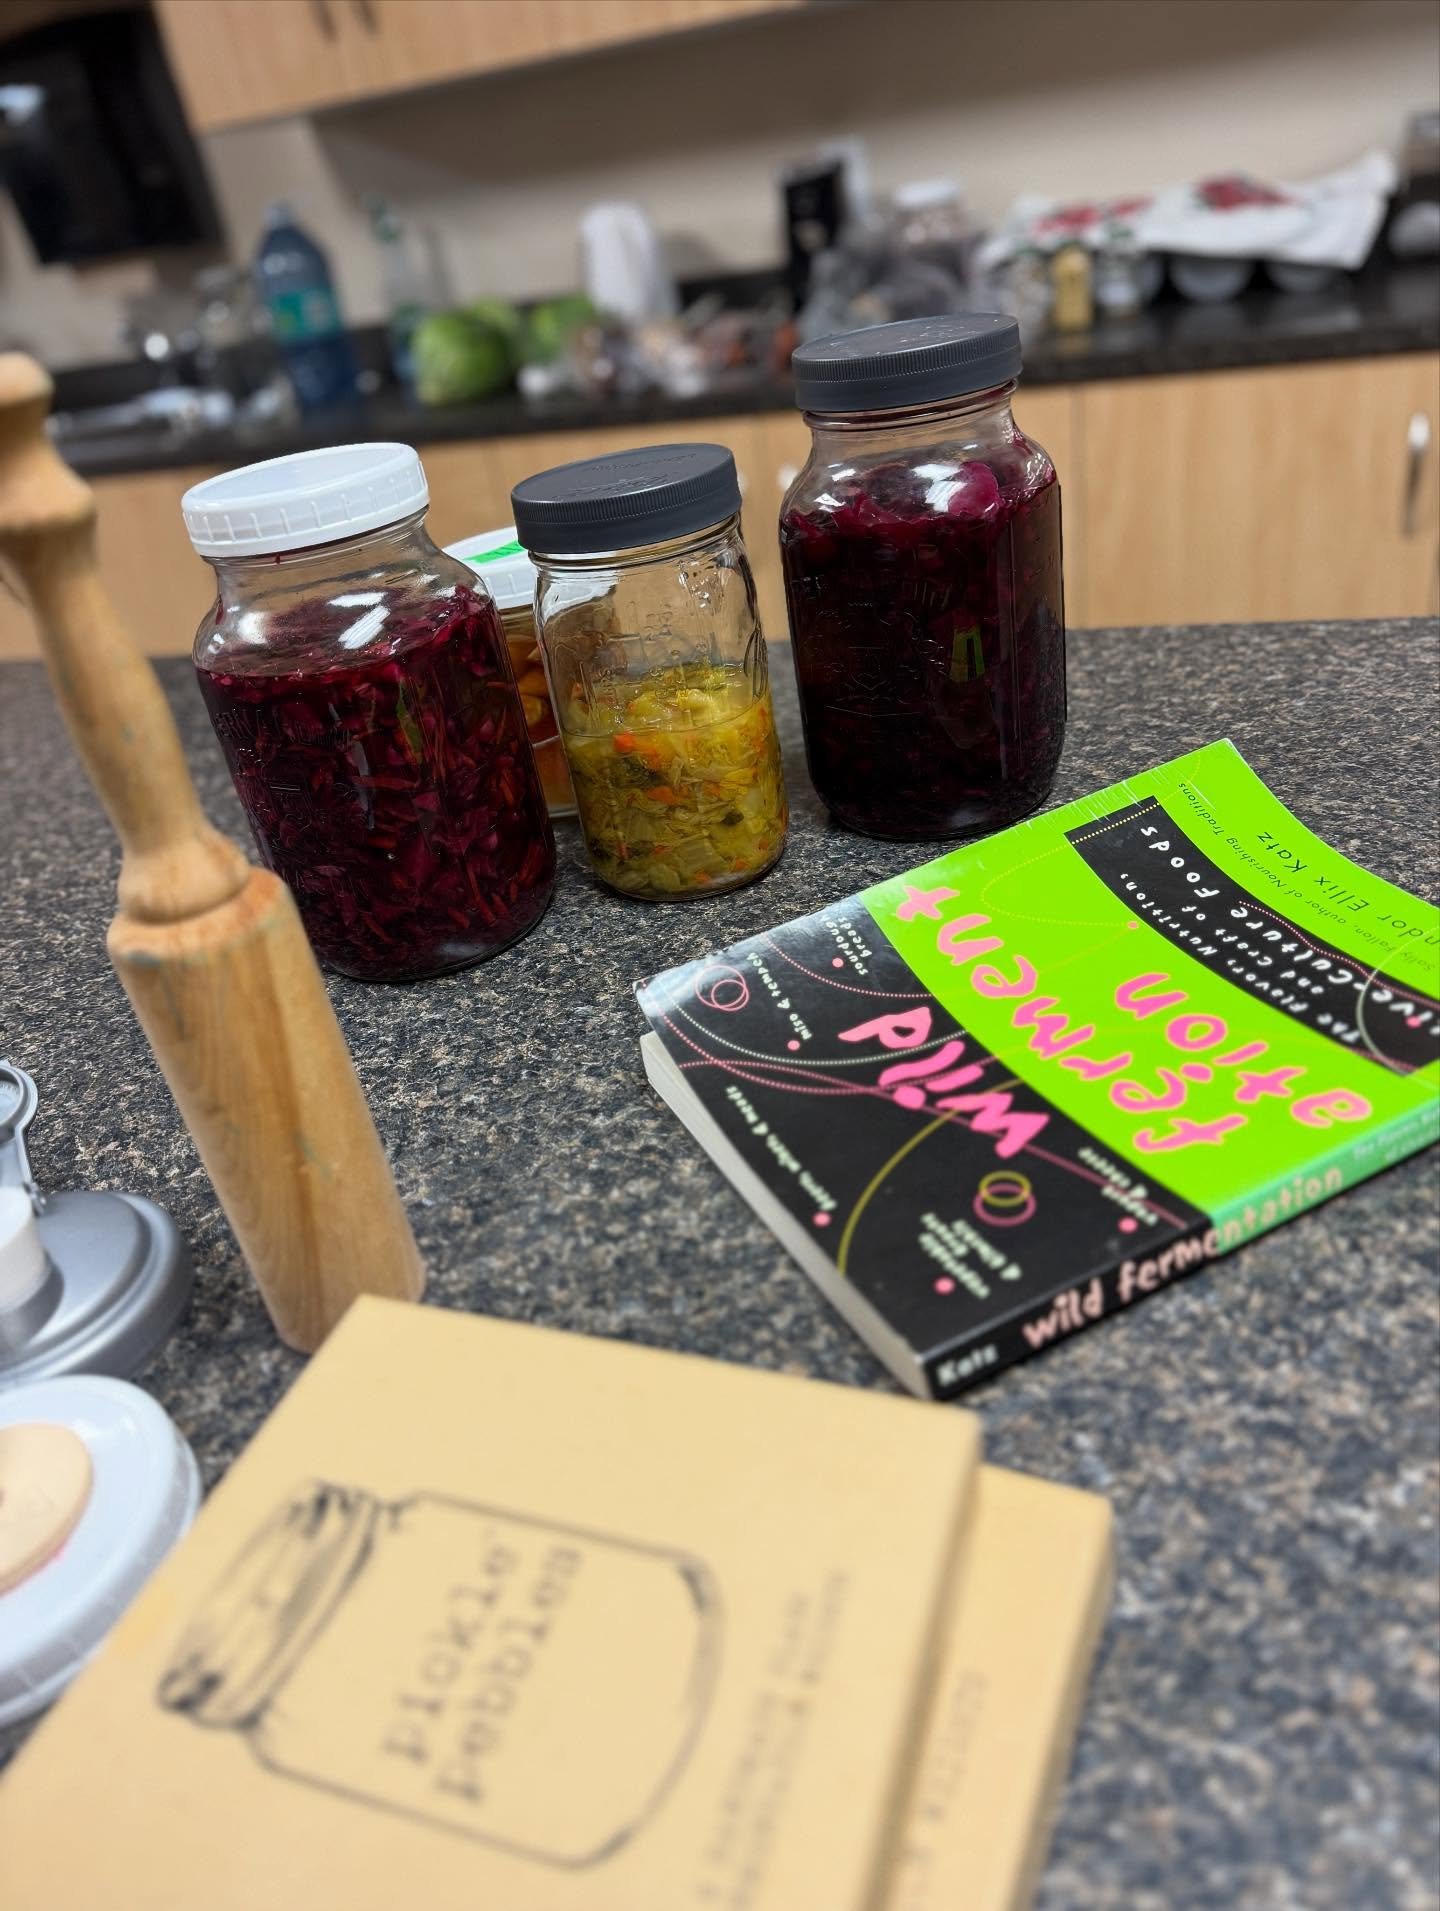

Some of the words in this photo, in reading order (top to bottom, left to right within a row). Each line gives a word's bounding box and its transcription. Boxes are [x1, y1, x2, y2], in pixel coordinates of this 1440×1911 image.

[1178, 782, 1224, 836] Traditions
[1140, 826, 1219, 898] Foods
[1226, 838, 1282, 888] Nourishing
[1257, 831, 1308, 873] Katz
[1118, 871, 1218, 956] Nutrition,
[1181, 905, 1206, 921] of
[1284, 887, 1303, 899] of
[1306, 899, 1346, 924] author
[1314, 876, 1370, 911] Ellix
[837, 916, 873, 958] breads
[1215, 928, 1273, 966] Craft
[746, 952, 781, 997] tempeh
[1227, 959, 1308, 1012] Flavor,
[1280, 970, 1324, 994] and
[777, 997, 790, 1009] &
[896, 886, 1249, 1152] ferment
[789, 1013, 812, 1041] miso
[1317, 1013, 1361, 1043] The
[837, 1006, 1050, 1158] wild
[936, 1344, 998, 1388] Katz
[1022, 1278, 1104, 1348] wild
[1118, 1167, 1342, 1302] fermentation
[434, 1546, 584, 1804] pebbles
